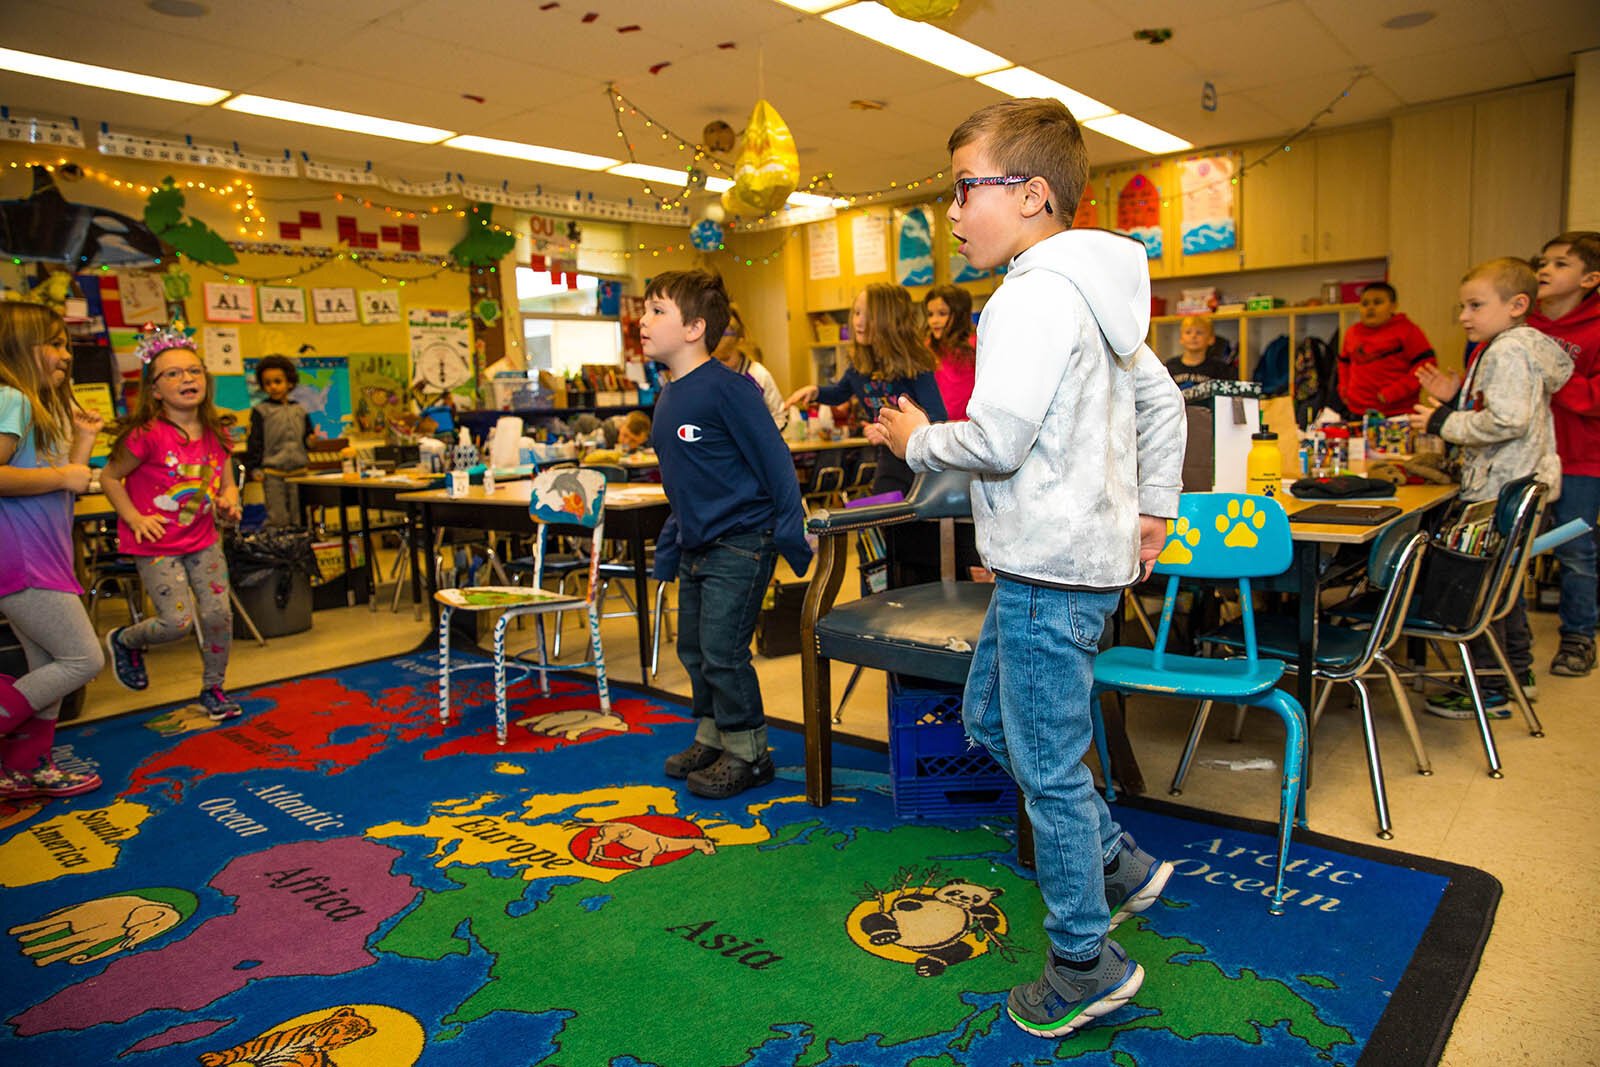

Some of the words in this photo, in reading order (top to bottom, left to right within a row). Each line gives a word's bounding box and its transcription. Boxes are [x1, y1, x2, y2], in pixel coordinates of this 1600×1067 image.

[76, 810, 130, 842] South
[198, 798, 268, 837] Ocean
[247, 784, 344, 831] Atlantic
[28, 824, 90, 868] America
[453, 816, 575, 870] Europe
[1183, 838, 1363, 885] Arctic
[264, 867, 364, 921] Africa
[1169, 858, 1341, 913] Ocean
[665, 920, 784, 970] Asia
